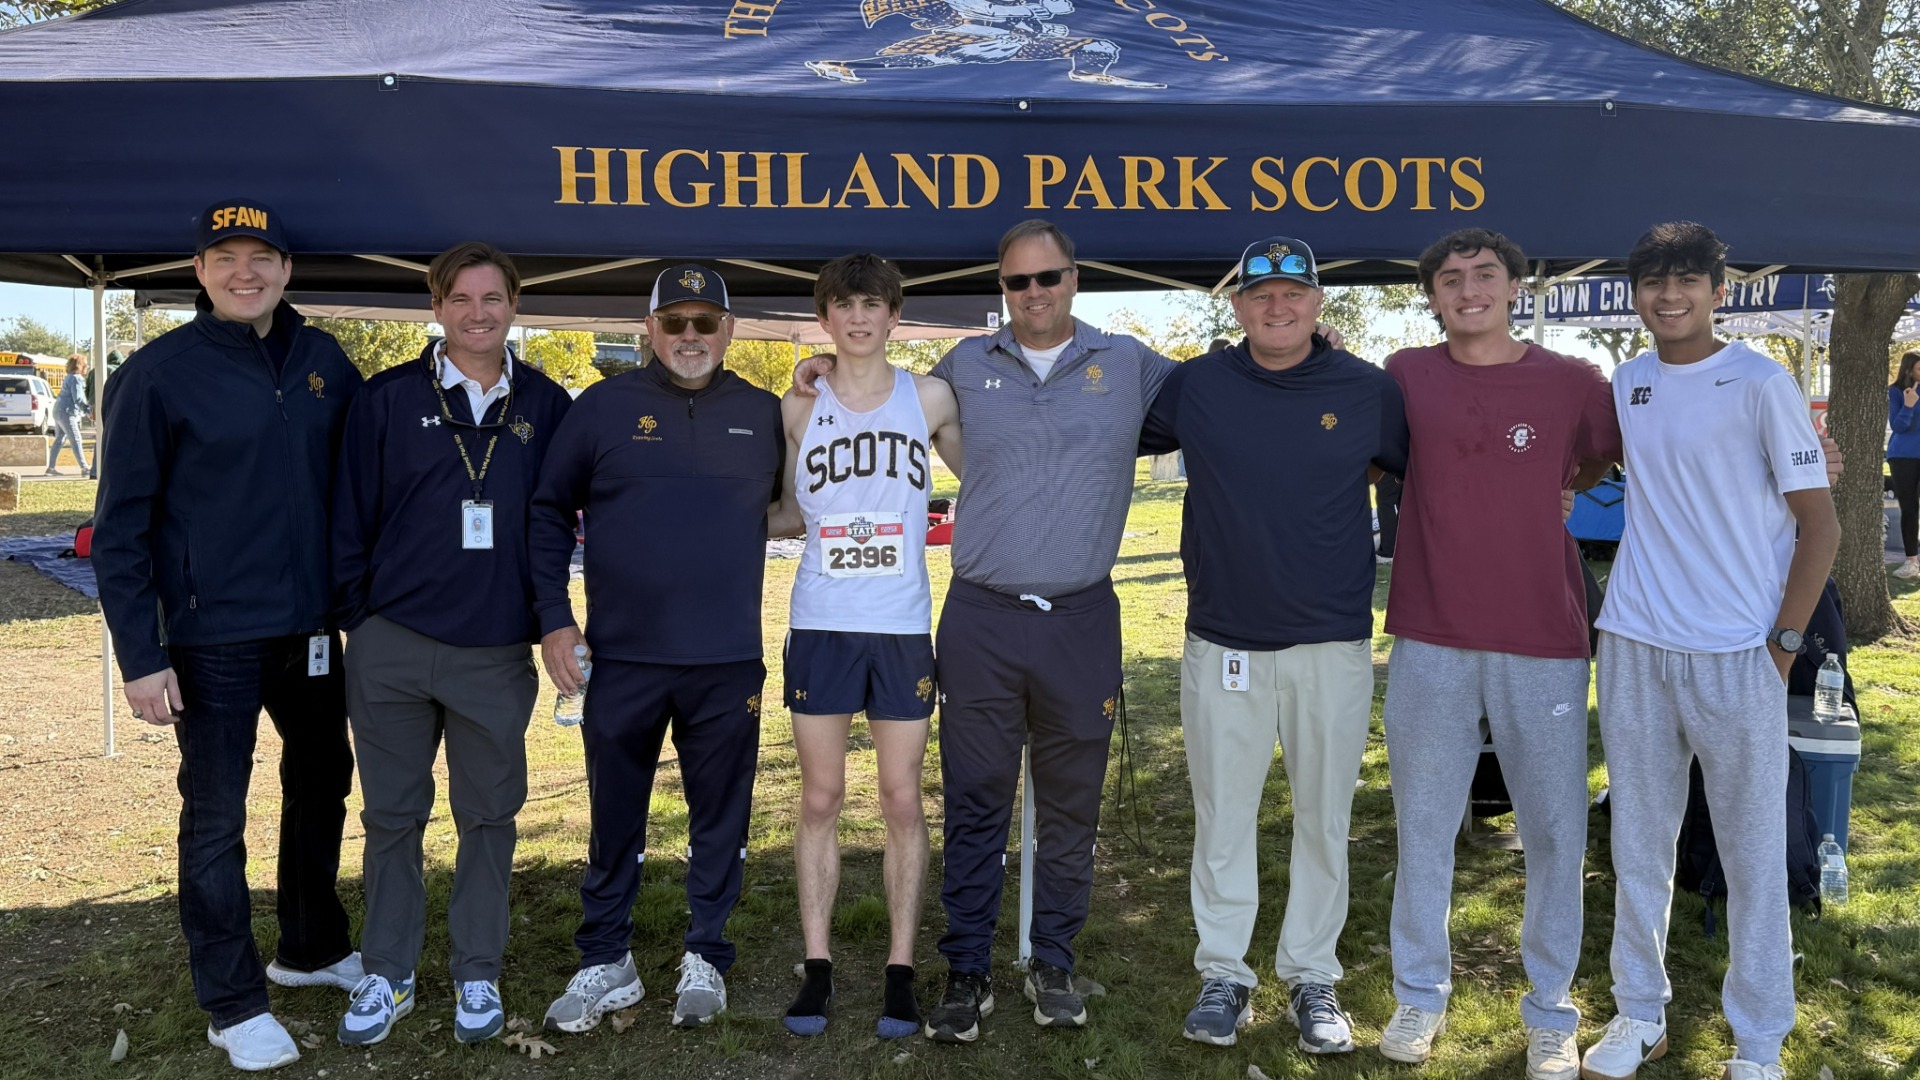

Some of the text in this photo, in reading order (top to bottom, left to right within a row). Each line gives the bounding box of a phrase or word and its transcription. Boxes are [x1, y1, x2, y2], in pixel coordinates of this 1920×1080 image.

[724, 0, 783, 39] TH
[1114, 0, 1229, 61] COTS
[552, 146, 1485, 212] HIGHLAND PARK SCOTS
[212, 206, 267, 230] SFAW
[1721, 275, 1780, 307] NTRY
[806, 431, 926, 494] SCOTS
[847, 526, 878, 535] STATE
[829, 545, 897, 570] 2396
[1556, 703, 1571, 712] NIKE
